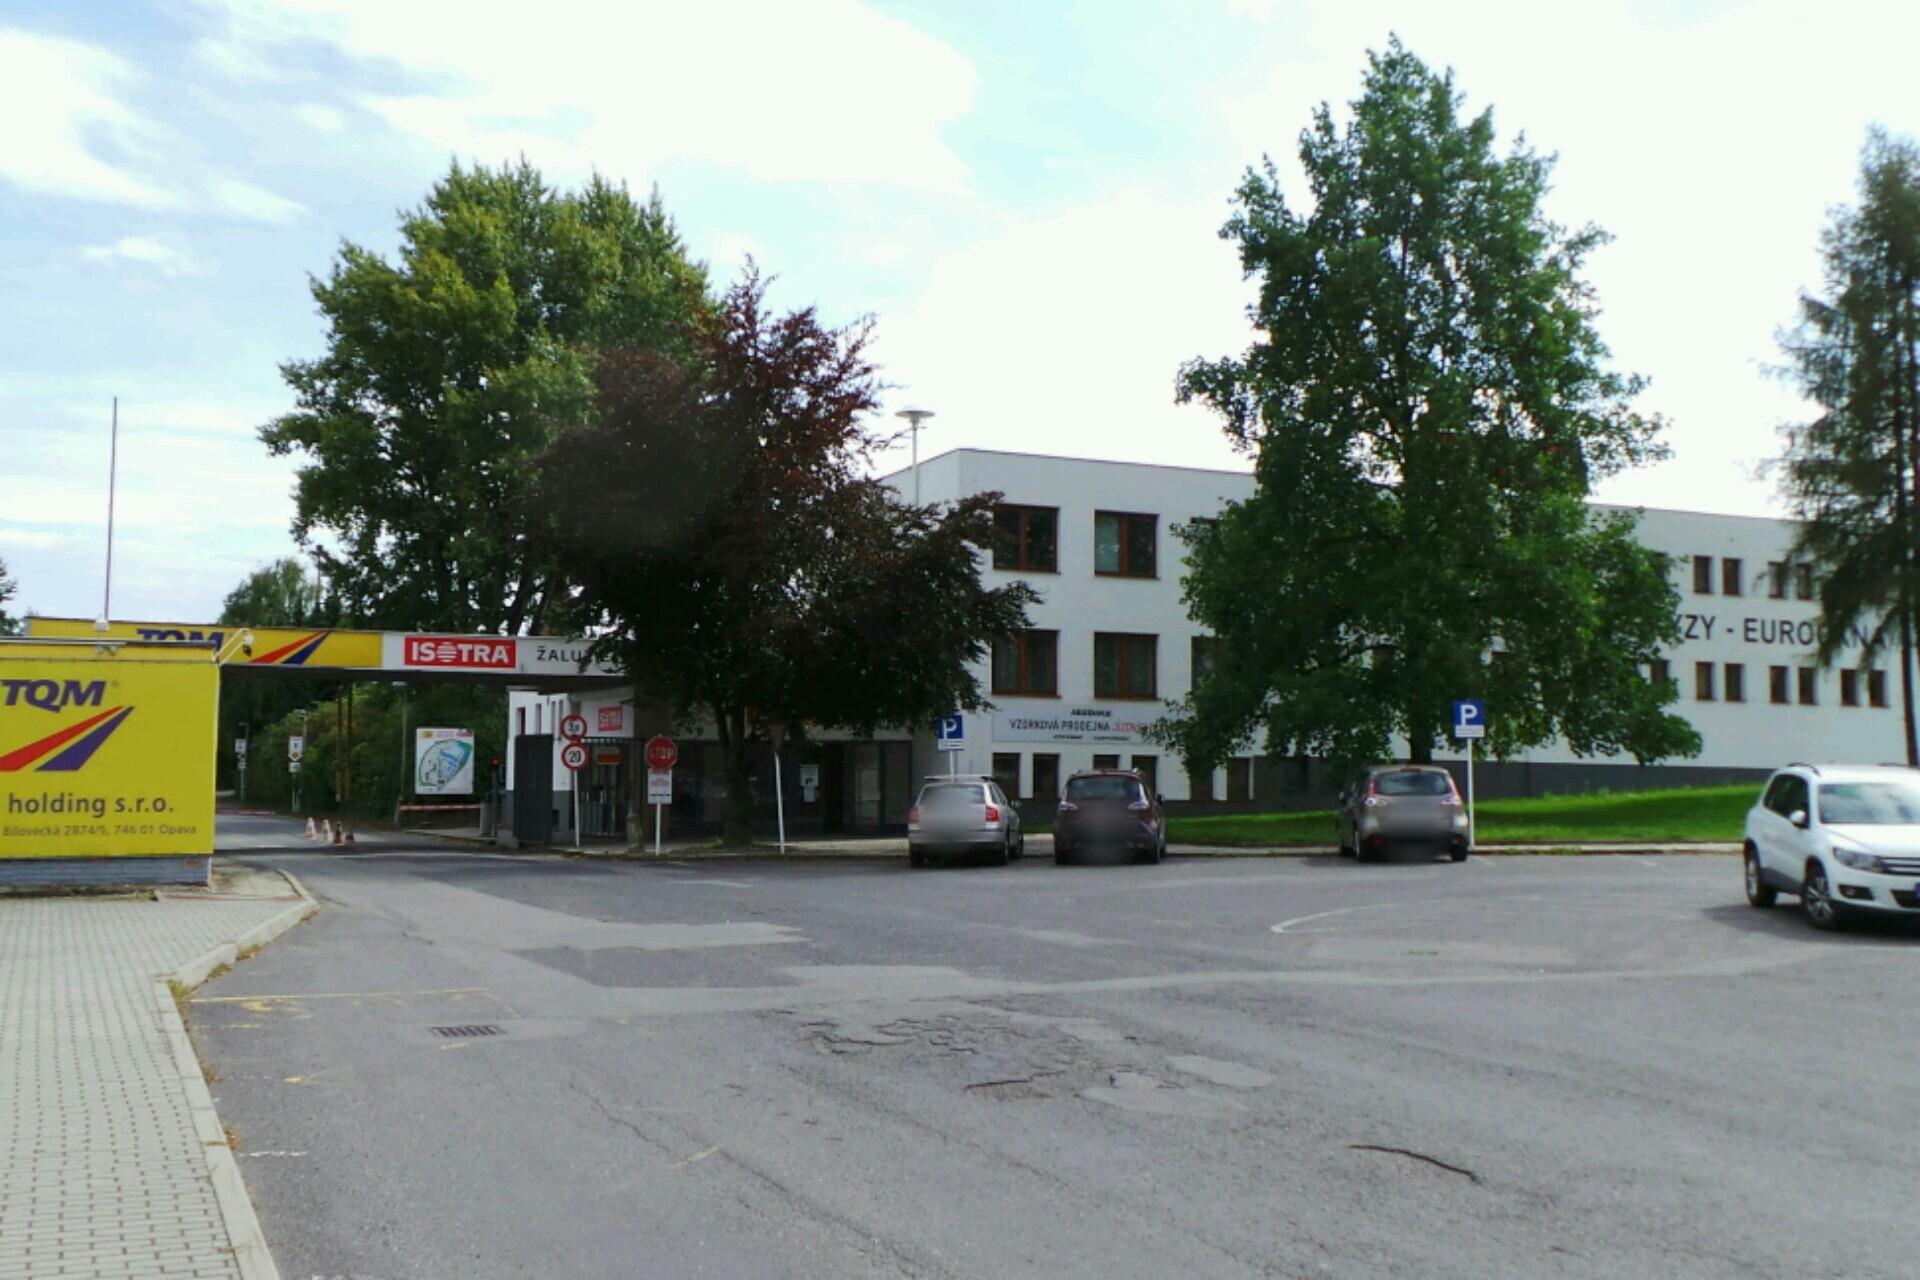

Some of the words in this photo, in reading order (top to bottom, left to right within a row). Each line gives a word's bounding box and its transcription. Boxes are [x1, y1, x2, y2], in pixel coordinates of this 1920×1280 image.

[412, 640, 509, 664] ISOTRA
[0, 679, 107, 713] TQM
[1461, 704, 1478, 726] P
[943, 718, 957, 739] P
[568, 750, 582, 763] 20
[8, 792, 106, 818] holding
[115, 797, 176, 813] s.r.o.
[115, 824, 137, 835] 746
[159, 824, 197, 836] Opava
